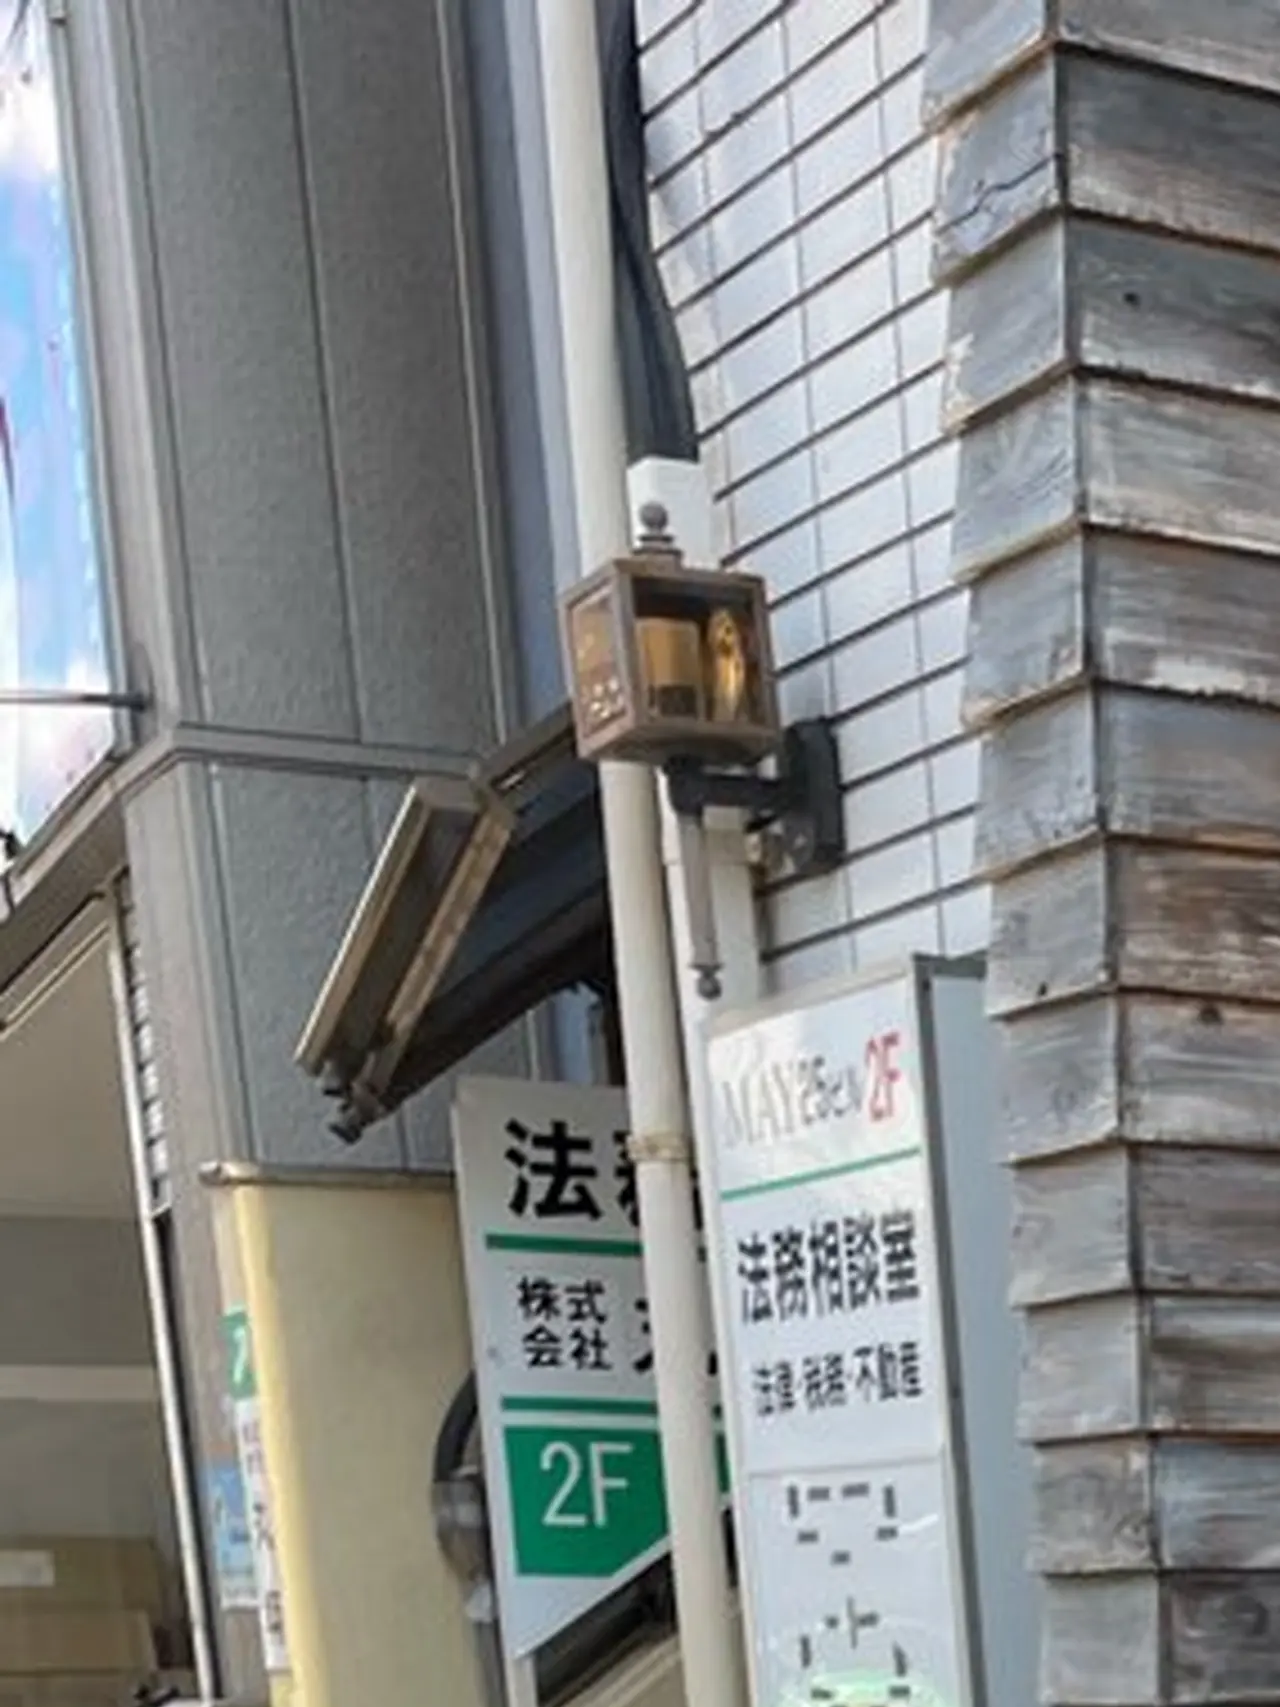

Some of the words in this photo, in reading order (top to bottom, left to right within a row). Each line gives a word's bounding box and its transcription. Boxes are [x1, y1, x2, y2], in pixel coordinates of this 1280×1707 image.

[865, 1030, 902, 1123] 2F
[517, 1276, 607, 1325] 株式
[736, 1210, 920, 1325] 法務相談室
[522, 1325, 613, 1371] 会社
[541, 1440, 633, 1527] 2F
